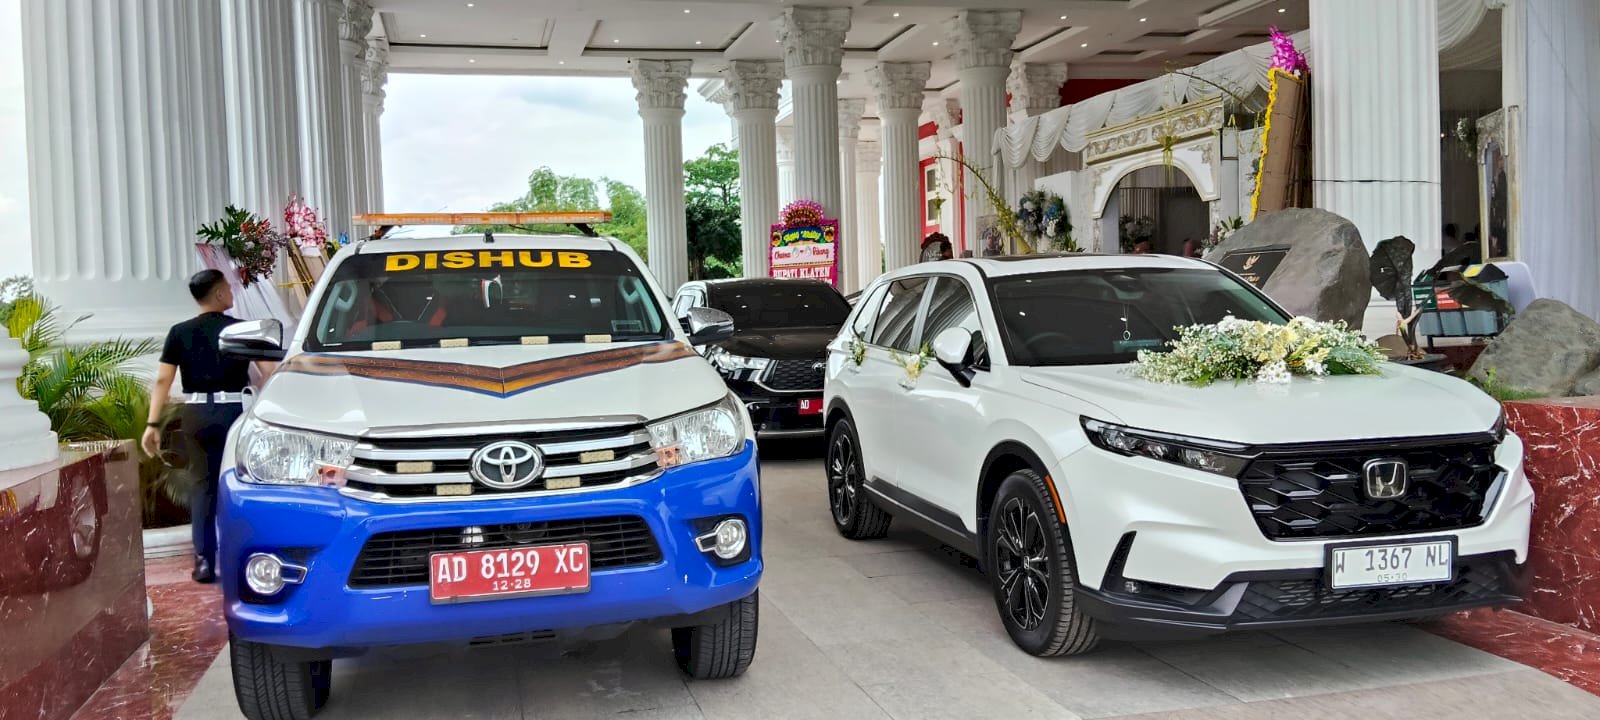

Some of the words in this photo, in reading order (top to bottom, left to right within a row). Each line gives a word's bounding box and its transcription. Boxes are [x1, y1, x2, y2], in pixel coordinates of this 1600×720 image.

[385, 251, 592, 271] DISHUB
[774, 269, 798, 278] BUPATI
[800, 267, 830, 277] KLATEN
[800, 399, 810, 409] AD
[437, 557, 467, 583] AD
[481, 550, 540, 579] 8129
[554, 547, 584, 574] XC
[1335, 551, 1345, 574] W
[1365, 547, 1412, 572] 1367
[1426, 545, 1448, 568] NL
